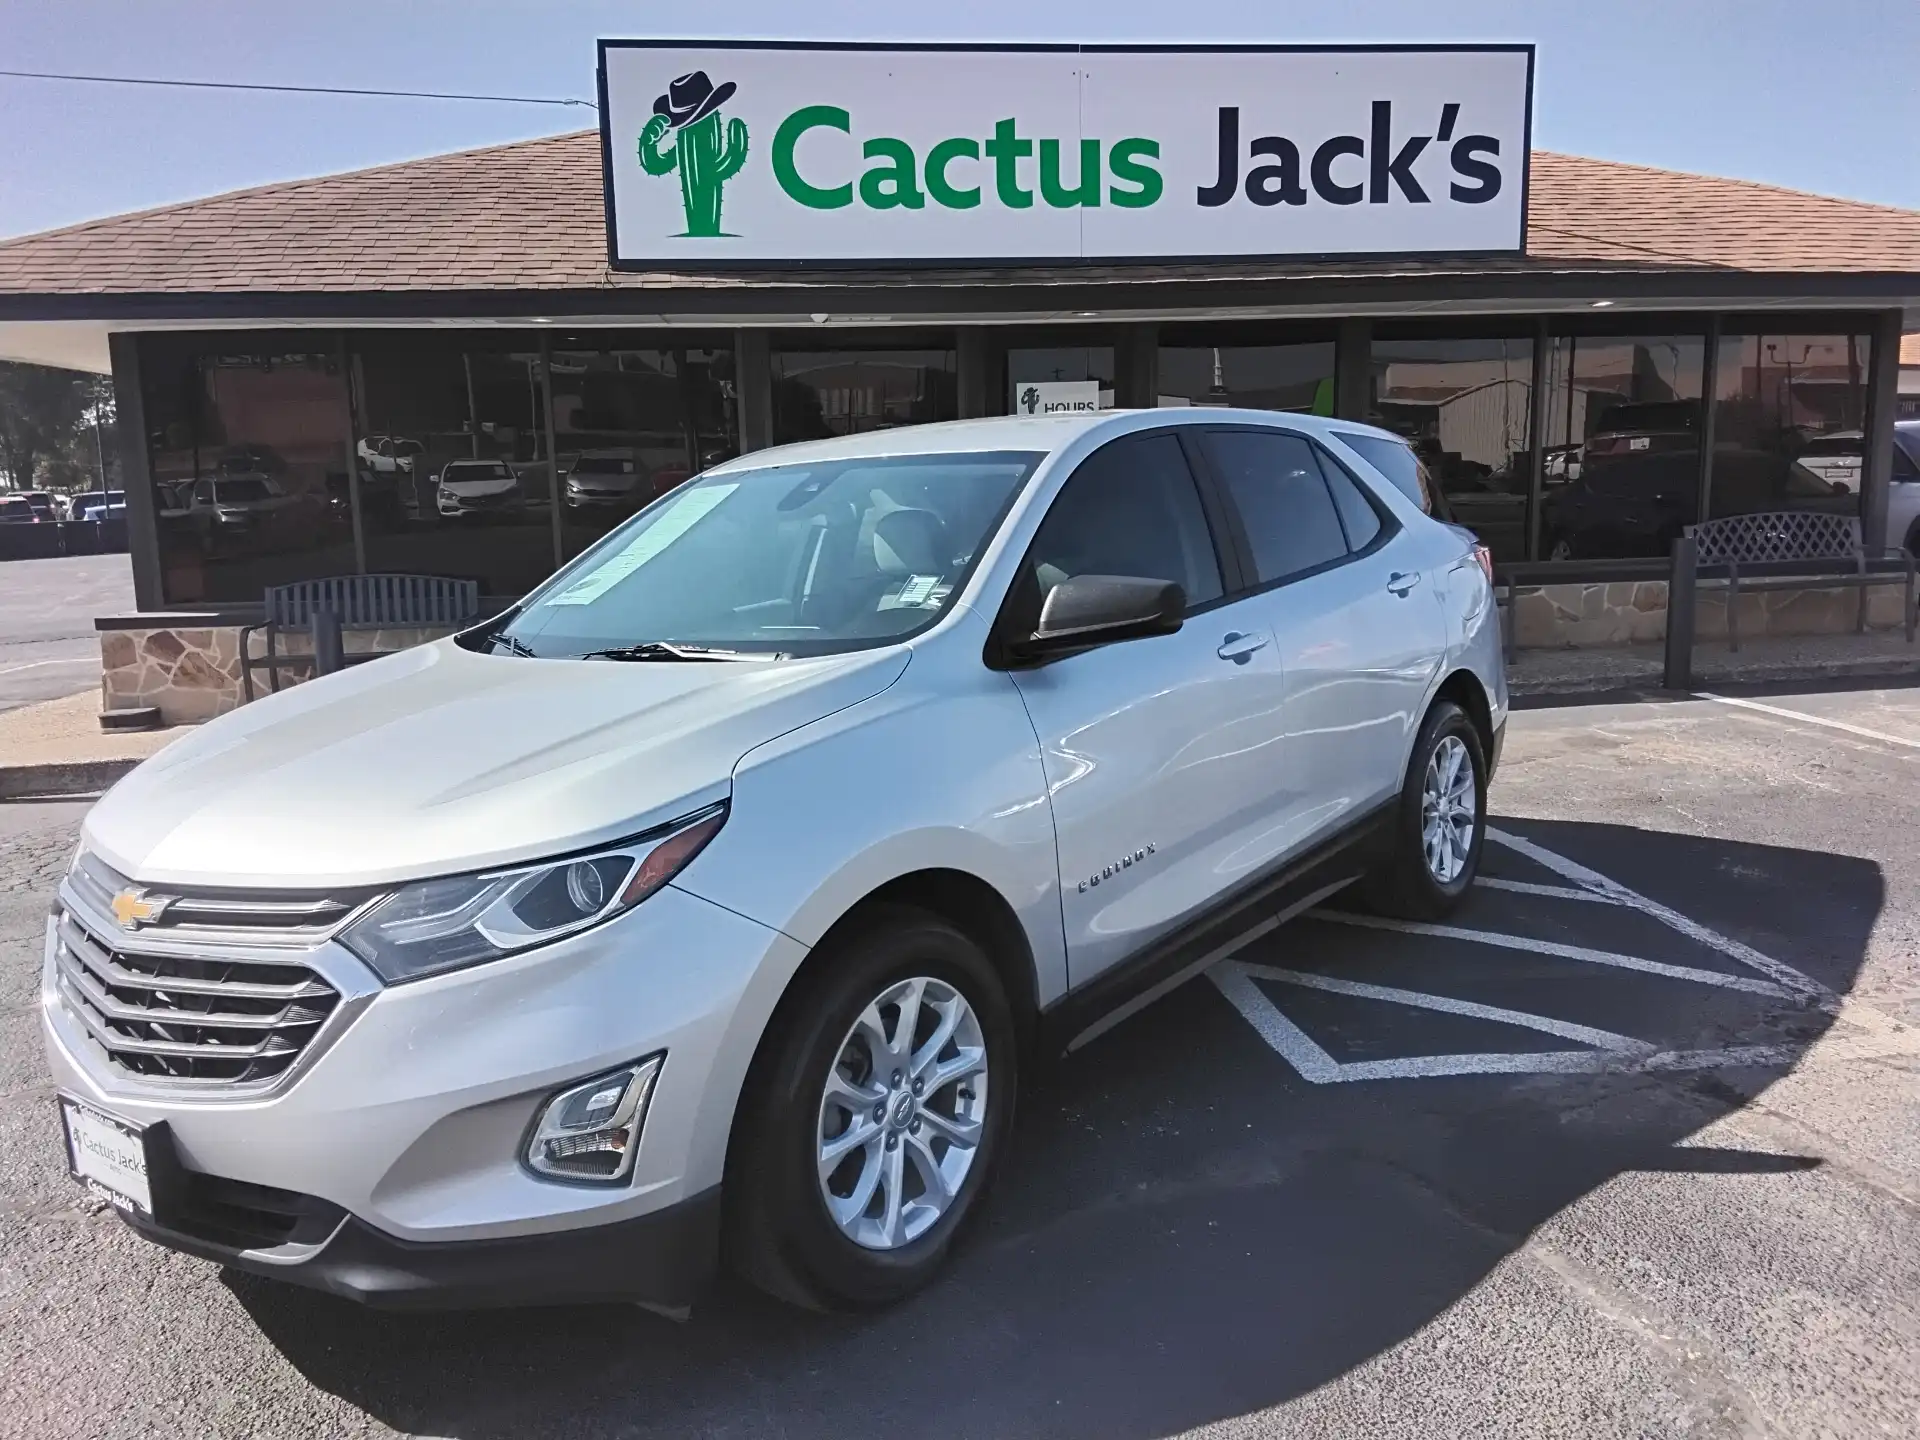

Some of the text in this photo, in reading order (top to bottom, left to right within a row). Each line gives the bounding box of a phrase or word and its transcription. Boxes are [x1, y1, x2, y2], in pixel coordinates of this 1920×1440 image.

[771, 100, 1503, 210] Cactus Jack's
[1044, 402, 1095, 413] HOURS
[1077, 841, 1156, 894] EQUINOX
[82, 1131, 116, 1161] Cactus
